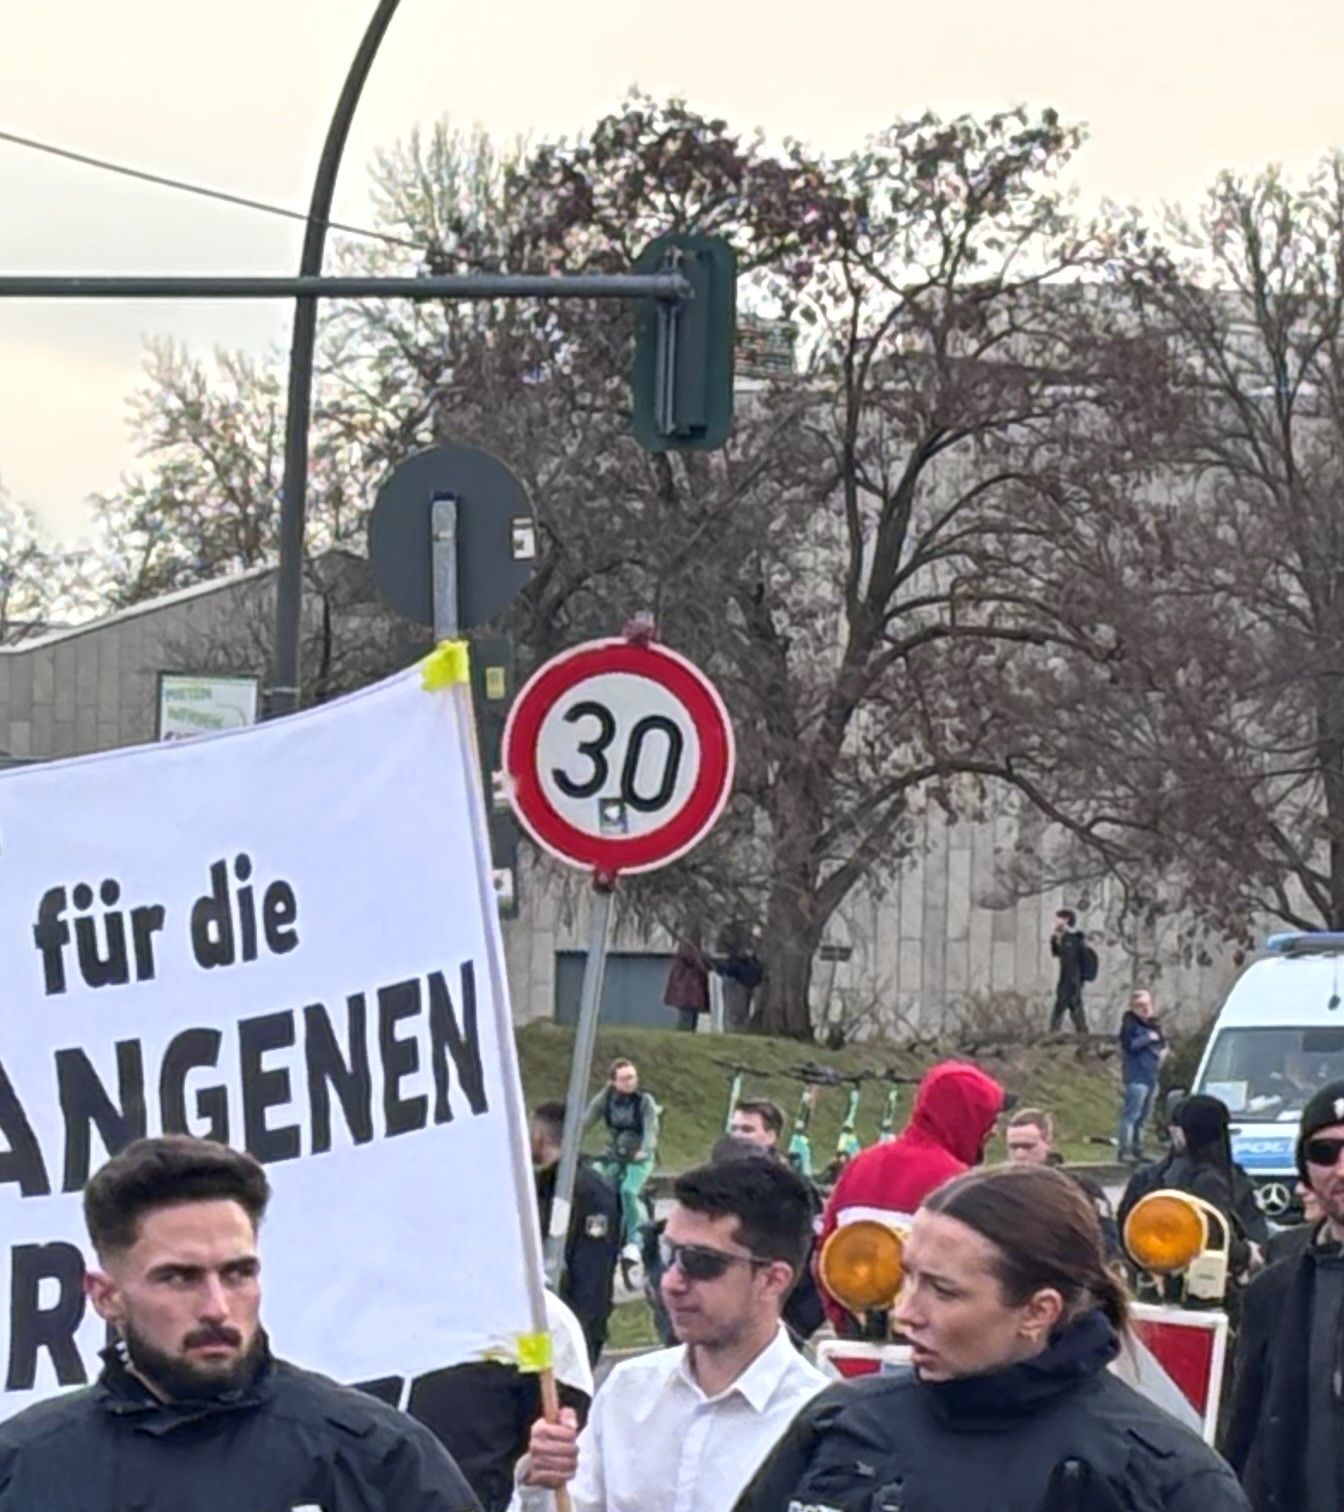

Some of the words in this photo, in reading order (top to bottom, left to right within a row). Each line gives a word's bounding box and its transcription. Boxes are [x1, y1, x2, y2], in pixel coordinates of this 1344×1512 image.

[552, 700, 684, 814] 30
[33, 878, 166, 996] für
[190, 852, 299, 970] die
